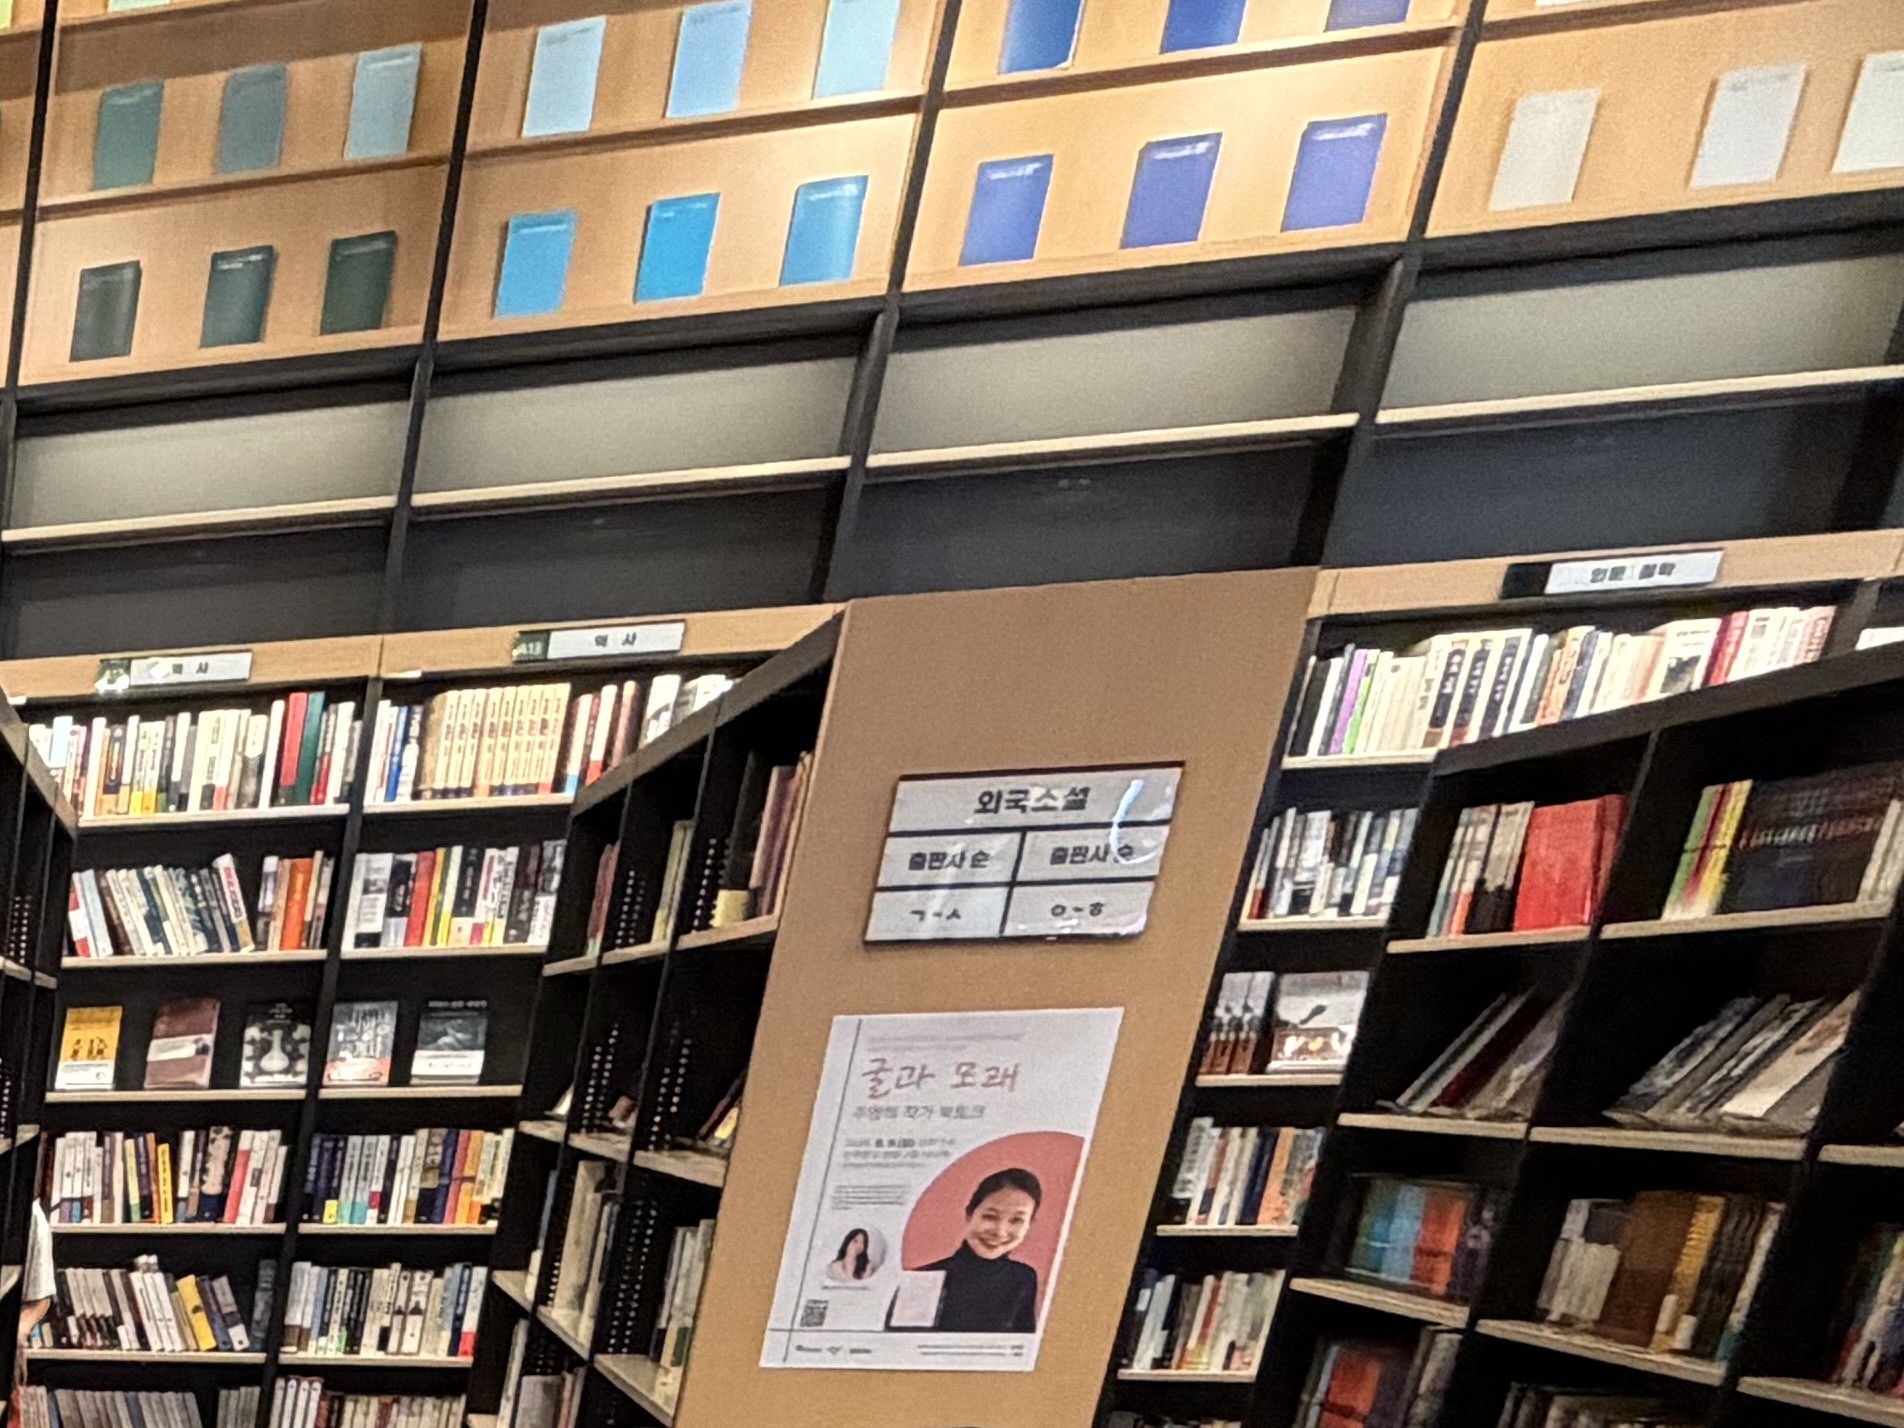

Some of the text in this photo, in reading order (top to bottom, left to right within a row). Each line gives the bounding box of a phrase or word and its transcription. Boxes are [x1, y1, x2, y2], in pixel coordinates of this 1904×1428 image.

[973, 786, 1091, 815] 외국소설
[908, 849, 990, 872] 출판사 순
[1049, 844, 1109, 866] 출판사
[951, 1062, 1021, 1093] 모래
